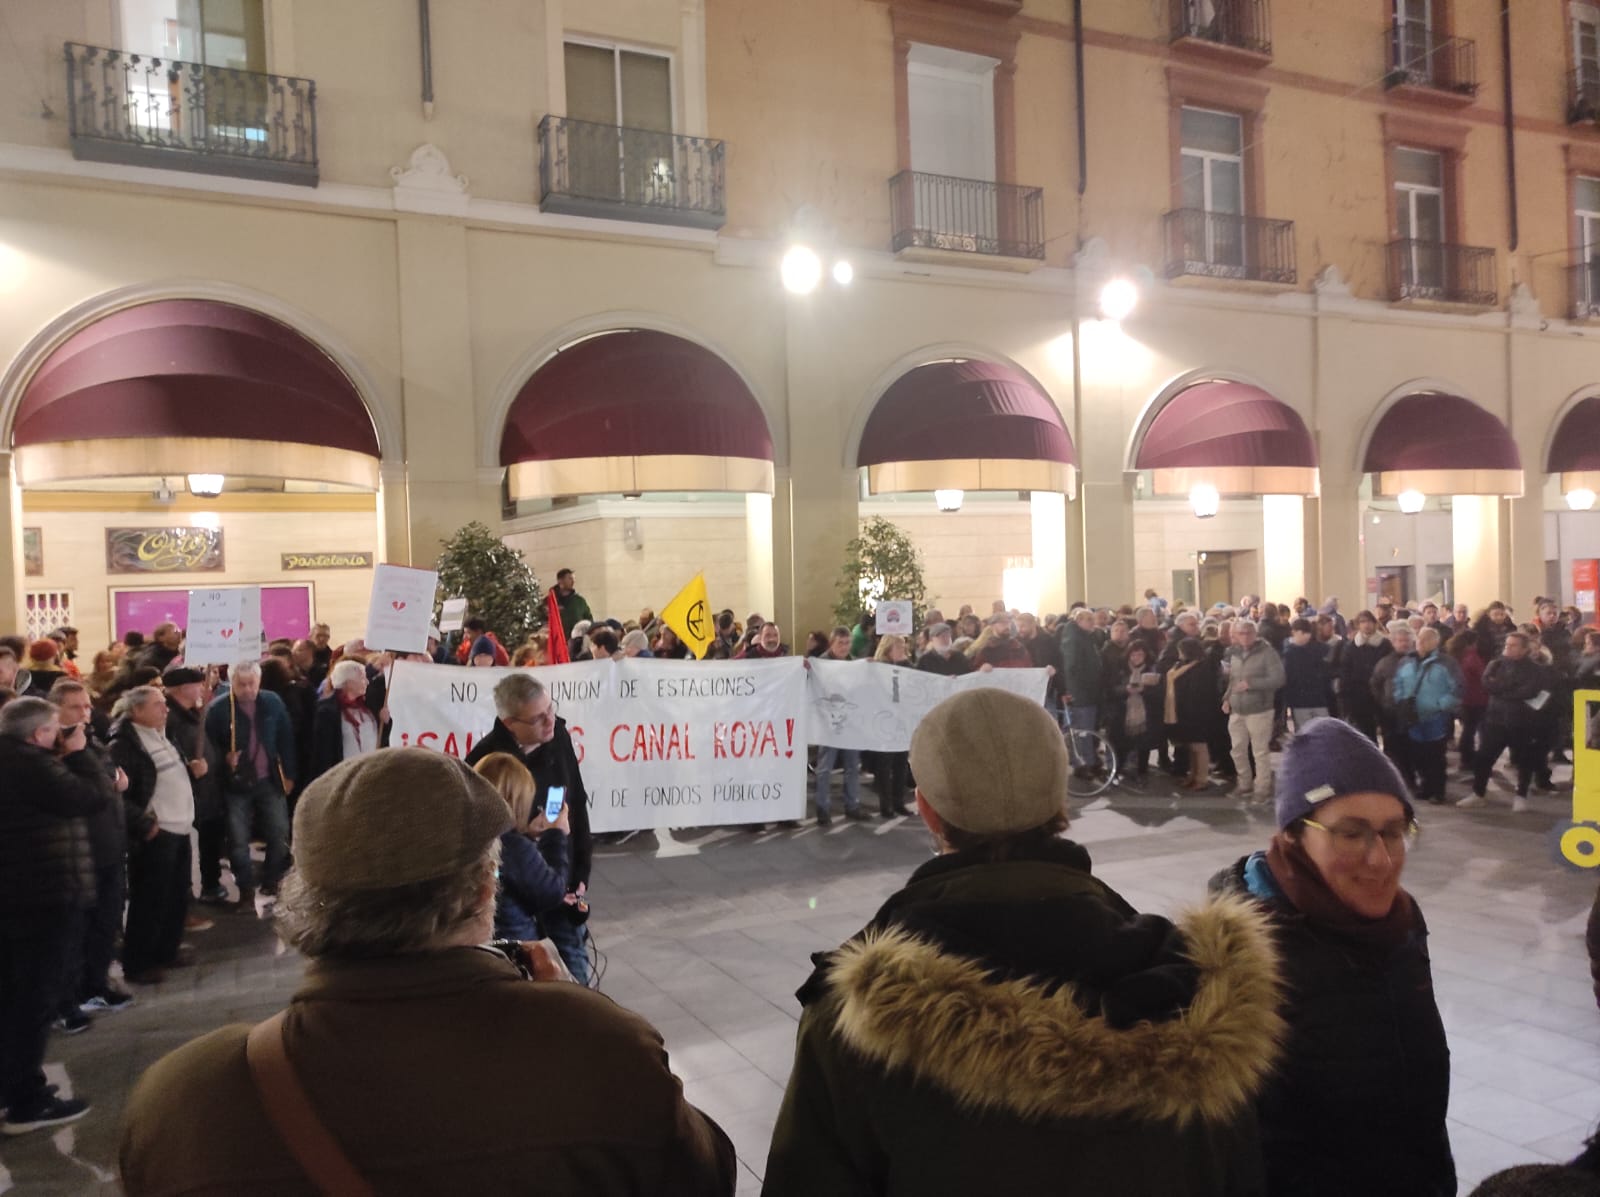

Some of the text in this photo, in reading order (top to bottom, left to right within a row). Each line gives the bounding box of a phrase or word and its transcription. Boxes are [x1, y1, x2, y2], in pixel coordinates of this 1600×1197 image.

[451, 682, 478, 703] NO
[620, 679, 638, 699] DE
[657, 676, 756, 698] ESTACIONES
[609, 722, 695, 762] CANAL
[714, 718, 795, 759] ROYA!
[611, 788, 628, 808] DE
[644, 784, 702, 806] FONDOS
[713, 777, 782, 803] PÚBLICOS
